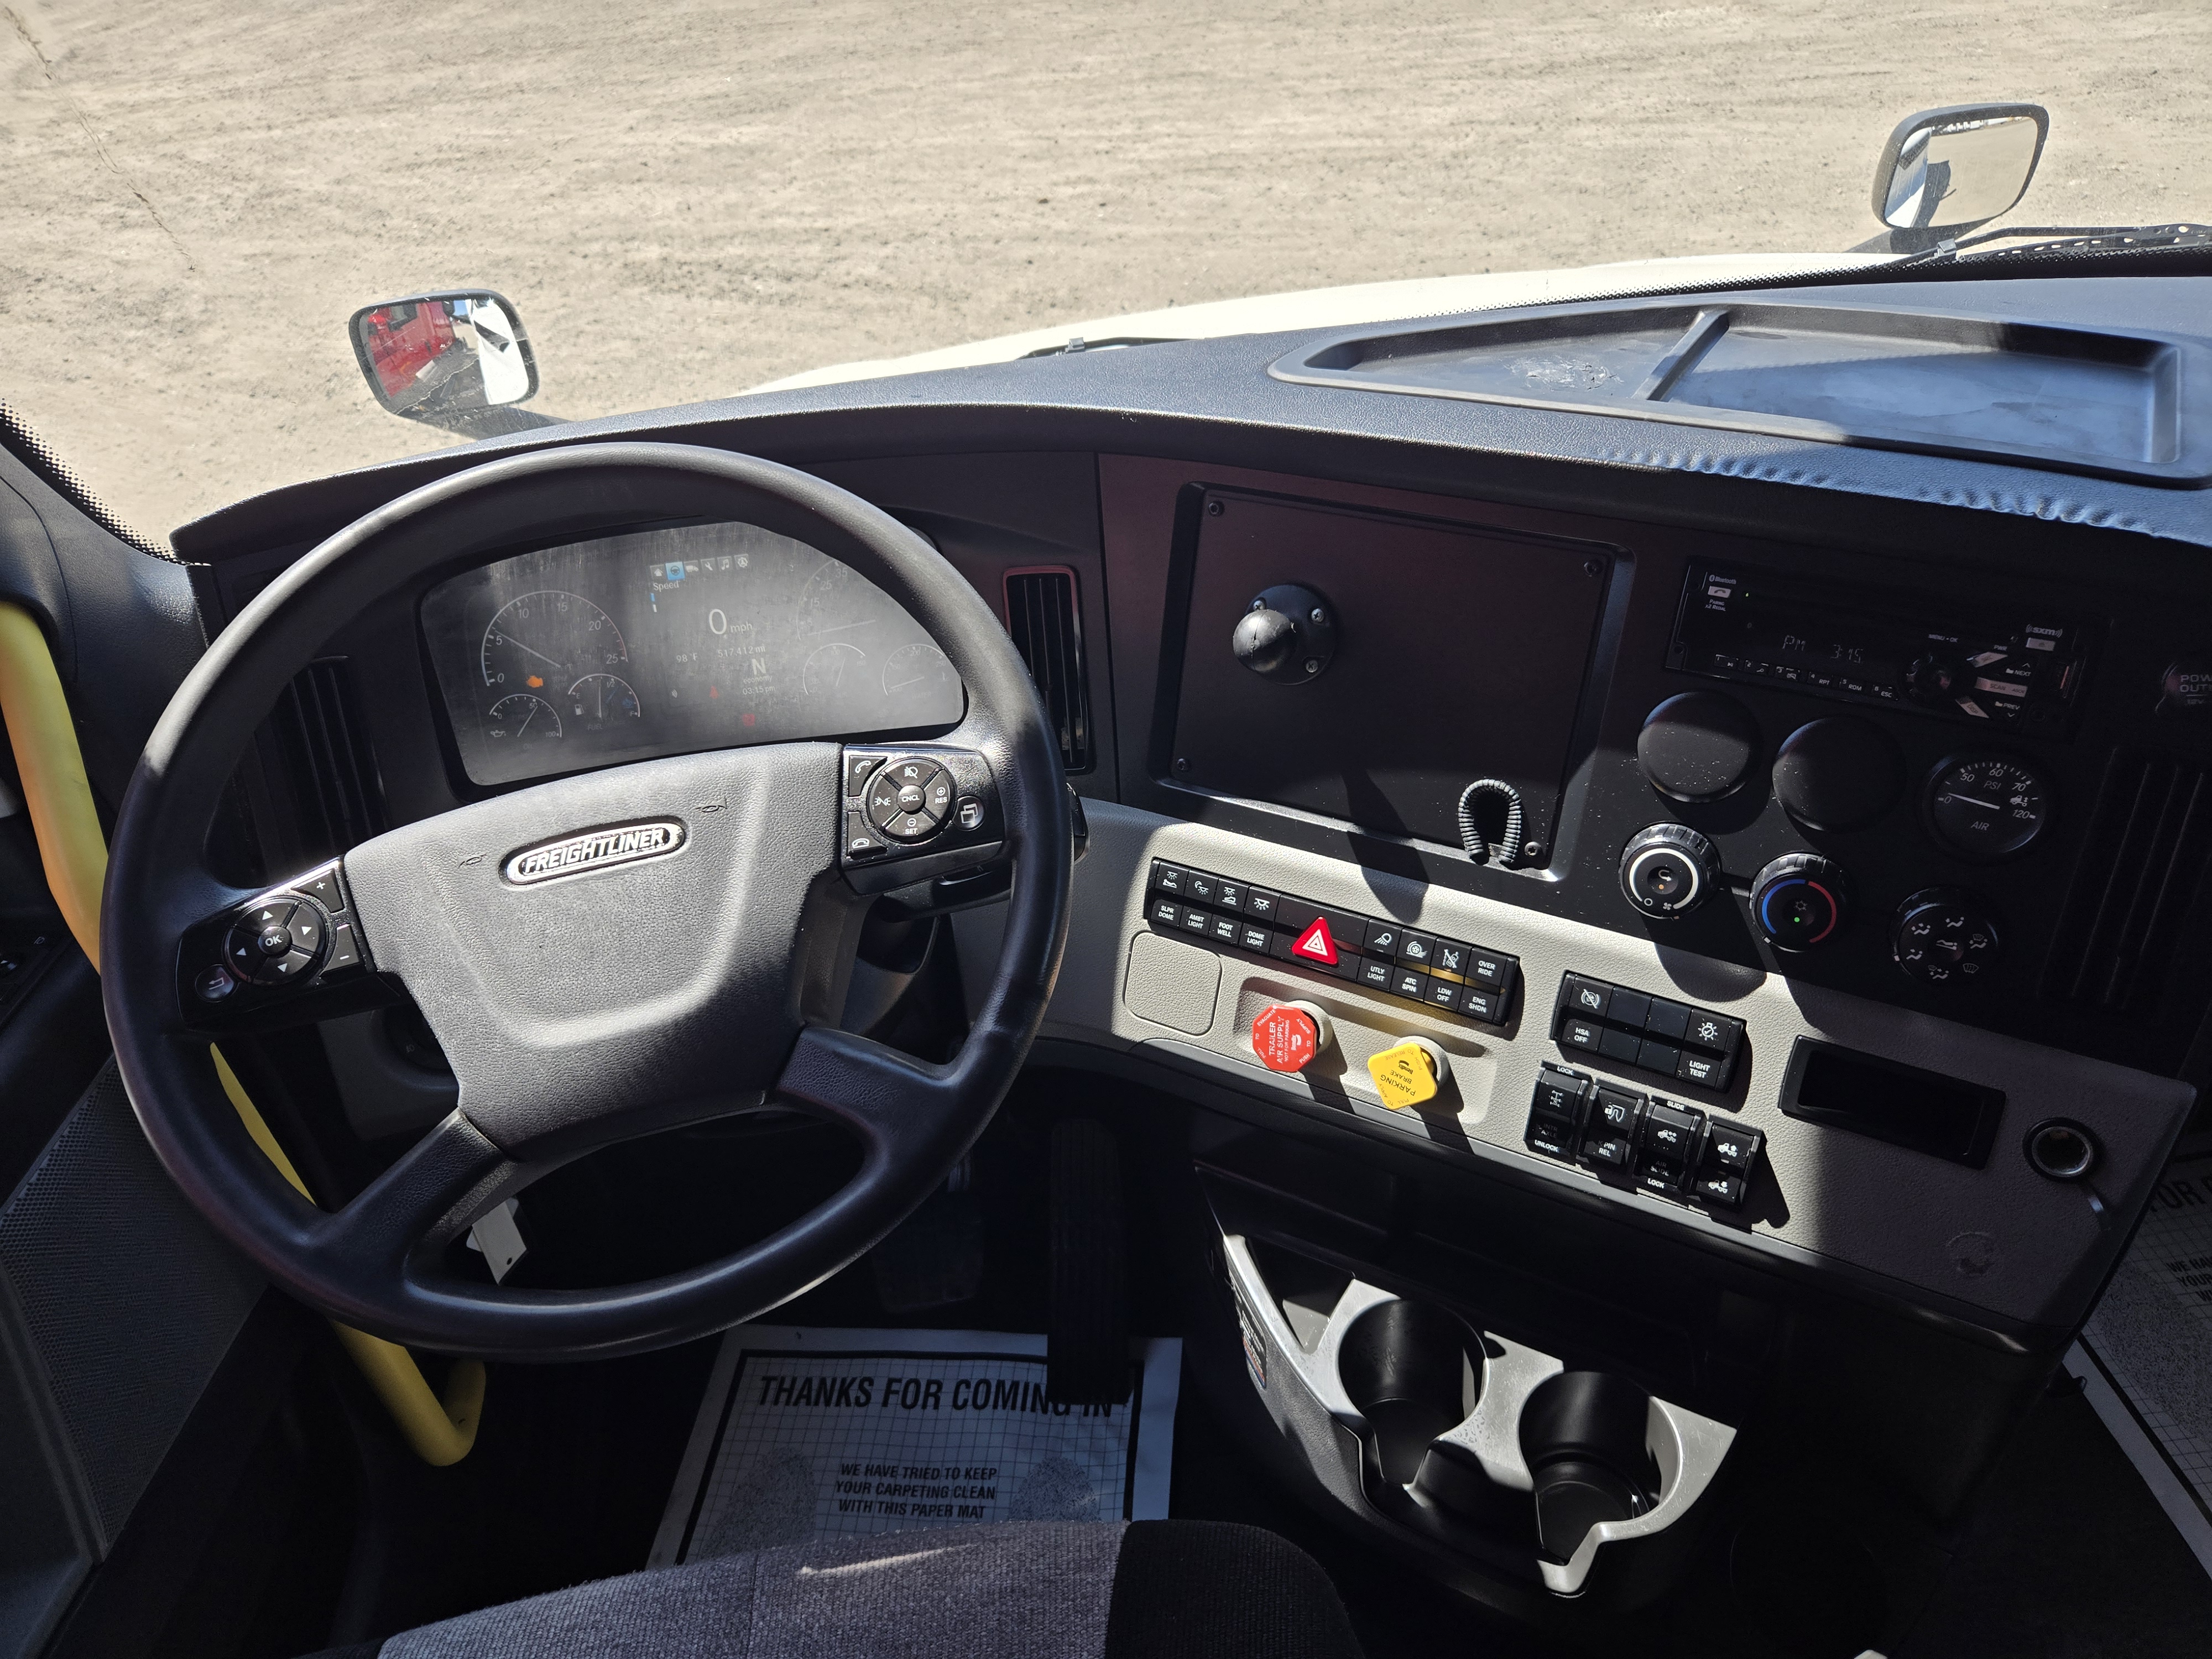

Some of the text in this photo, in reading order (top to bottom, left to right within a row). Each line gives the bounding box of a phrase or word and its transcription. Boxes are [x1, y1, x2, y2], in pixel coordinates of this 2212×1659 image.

[836, 567, 848, 578] 35
[653, 580, 680, 592] Speed
[820, 581, 832, 590] 25
[1715, 576, 1736, 585] Bluetooth
[557, 603, 568, 612] 15
[810, 597, 820, 607] 15
[519, 609, 529, 619] 10
[588, 620, 602, 631] 20
[708, 608, 753, 635] 0 mph
[496, 635, 503, 645] 5
[606, 654, 618, 664] 25
[676, 654, 688, 664] 98
[751, 657, 767, 675] N
[497, 672, 505, 684] 0
[743, 675, 773, 685] economy
[742, 685, 776, 695] 03:15 pm
[1960, 774, 1975, 782] 50
[1989, 768, 2004, 778] 60
[1984, 780, 2001, 790] PSI
[2012, 782, 2026, 792] 70
[901, 794, 920, 802] CNCL
[1944, 796, 1952, 804] 0
[2012, 809, 2030, 819] 120
[1970, 820, 1990, 831] AIR
[524, 828, 665, 874] FREIGHTLINER
[1161, 905, 1175, 914] SLPR
[1158, 911, 1174, 921] DOME
[1188, 914, 1204, 924] AMBT
[1187, 919, 1203, 930] LIGHT
[1218, 922, 1234, 932] FOOT
[1217, 927, 1232, 938] WELL
[1248, 930, 1265, 941] DOME
[264, 935, 283, 947] OK
[1246, 937, 1264, 948] LIGHT
[1370, 965, 1386, 975] UTLY
[1478, 960, 1495, 971] OVER
[1368, 971, 1385, 983] LIGHT
[1478, 966, 1494, 977] RIDE
[1405, 977, 1417, 986] ATC
[1401, 983, 1417, 994] SPIN
[1437, 987, 1453, 997] LDW
[1437, 993, 1450, 1003] OFF
[1472, 996, 1486, 1006] ENG
[1468, 1003, 1488, 1014] SHDN
[1256, 1009, 1276, 1026] EVACUATE
[1296, 1018, 1311, 1034] SUPPLY
[1575, 1027, 1589, 1036] HSA
[1574, 1034, 1588, 1043] OFF
[1258, 1047, 1266, 1058] PULL
[1384, 1050, 1405, 1061] RELEASE
[1298, 1053, 1311, 1064] PUSH
[1415, 1057, 1423, 1071] PUSH
[1398, 1063, 1413, 1074] Bendix
[1557, 1066, 1574, 1076] LOCK
[1689, 1060, 1710, 1072] LIGHT
[1390, 1070, 1412, 1084] BRAKE
[1689, 1068, 1707, 1078] TEST
[1379, 1083, 1388, 1098] APPLY
[1380, 1074, 1416, 1096] PARKING
[1667, 1101, 1686, 1110] SLIDE
[1543, 1123, 1558, 1131] INTR
[1541, 1129, 1557, 1138] AXLE
[1534, 1139, 1559, 1153] UNLOCK
[1598, 1140, 1616, 1151] K-PIN
[1598, 1147, 1611, 1157] REL
[1650, 1165, 1670, 1177] SLIDE
[1647, 1177, 1665, 1189] LOCK
[2150, 1181, 2206, 1212] OR
[2166, 1260, 2191, 1272] WE
[760, 1376, 874, 1408] THANKS
[882, 1377, 942, 1411] FOR
[841, 1463, 998, 1481] WE HAVE TRIED TO KEEP
[836, 1480, 996, 1500] YOUR CARPETING CLEAN
[839, 1499, 987, 1519] WITH THIS PAPER MAT
